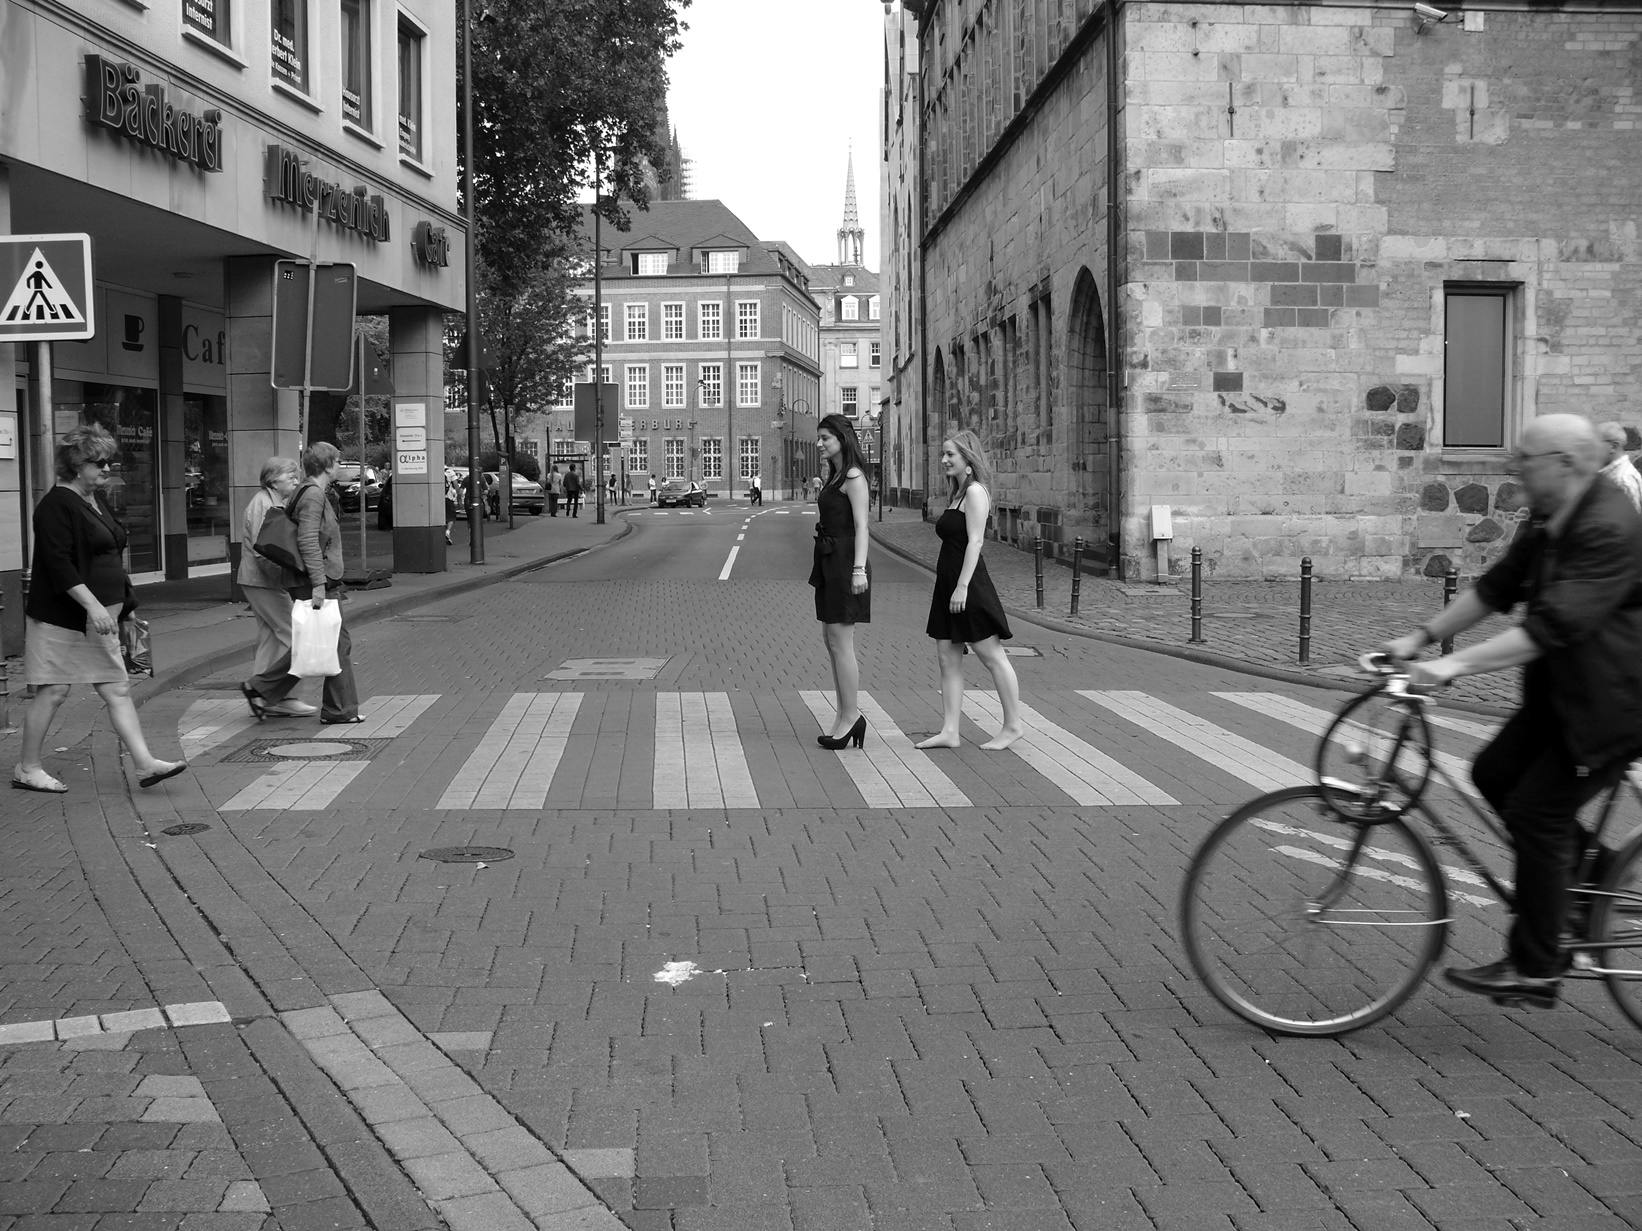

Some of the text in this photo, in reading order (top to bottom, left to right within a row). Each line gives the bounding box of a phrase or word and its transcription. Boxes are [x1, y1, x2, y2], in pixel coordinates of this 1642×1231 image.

[186, 2, 213, 30] Internist
[271, 44, 288, 62] erbert
[84, 54, 223, 173] Bäckerei
[267, 145, 391, 243] Merzenich
[182, 324, 226, 365] Caf
